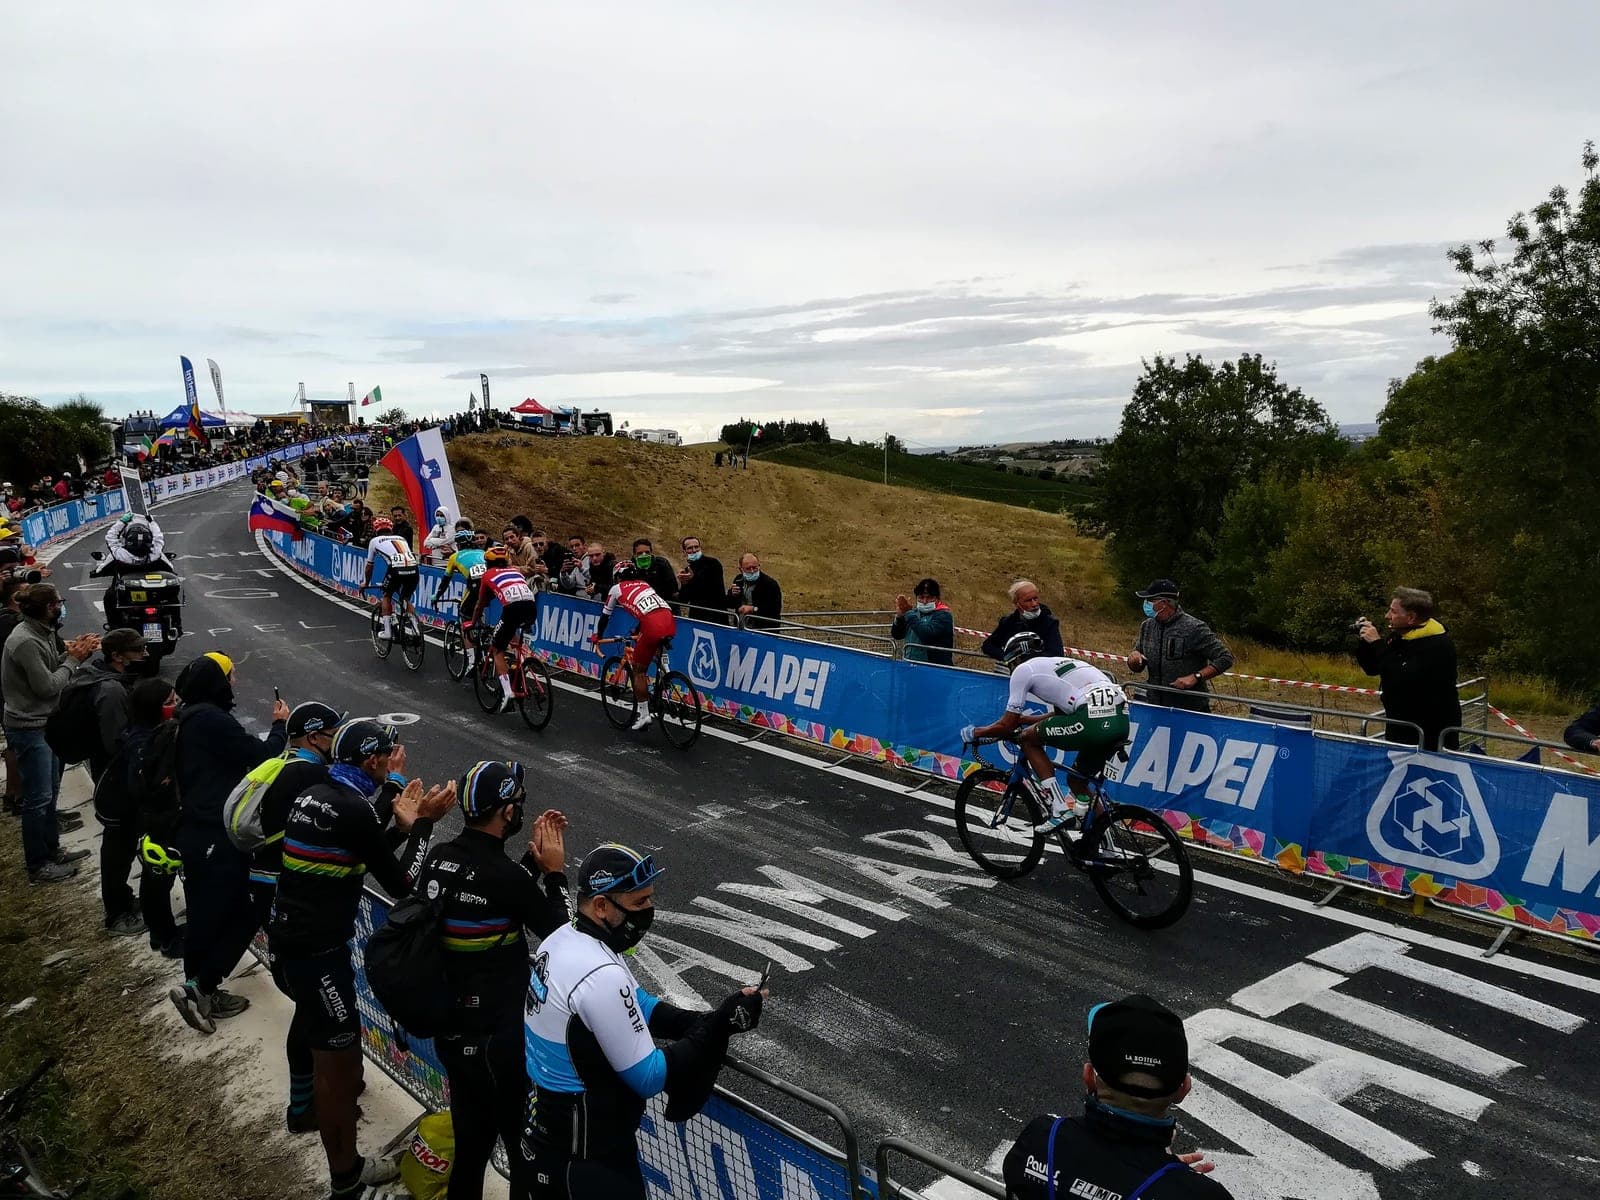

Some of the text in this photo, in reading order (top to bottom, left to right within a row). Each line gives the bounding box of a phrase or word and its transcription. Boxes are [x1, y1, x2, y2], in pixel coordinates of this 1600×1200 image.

[342, 550, 368, 587] MAP
[638, 596, 655, 609] 172
[725, 643, 831, 711] MAPEI
[1090, 688, 1115, 707] 175
[1045, 721, 1085, 737] MEXICO
[1103, 767, 1118, 781] 175
[630, 813, 1066, 1012] ANMARK
[320, 974, 332, 988] LA
[326, 985, 350, 1024] BOTTEGA
[618, 984, 645, 1034] #LBCC
